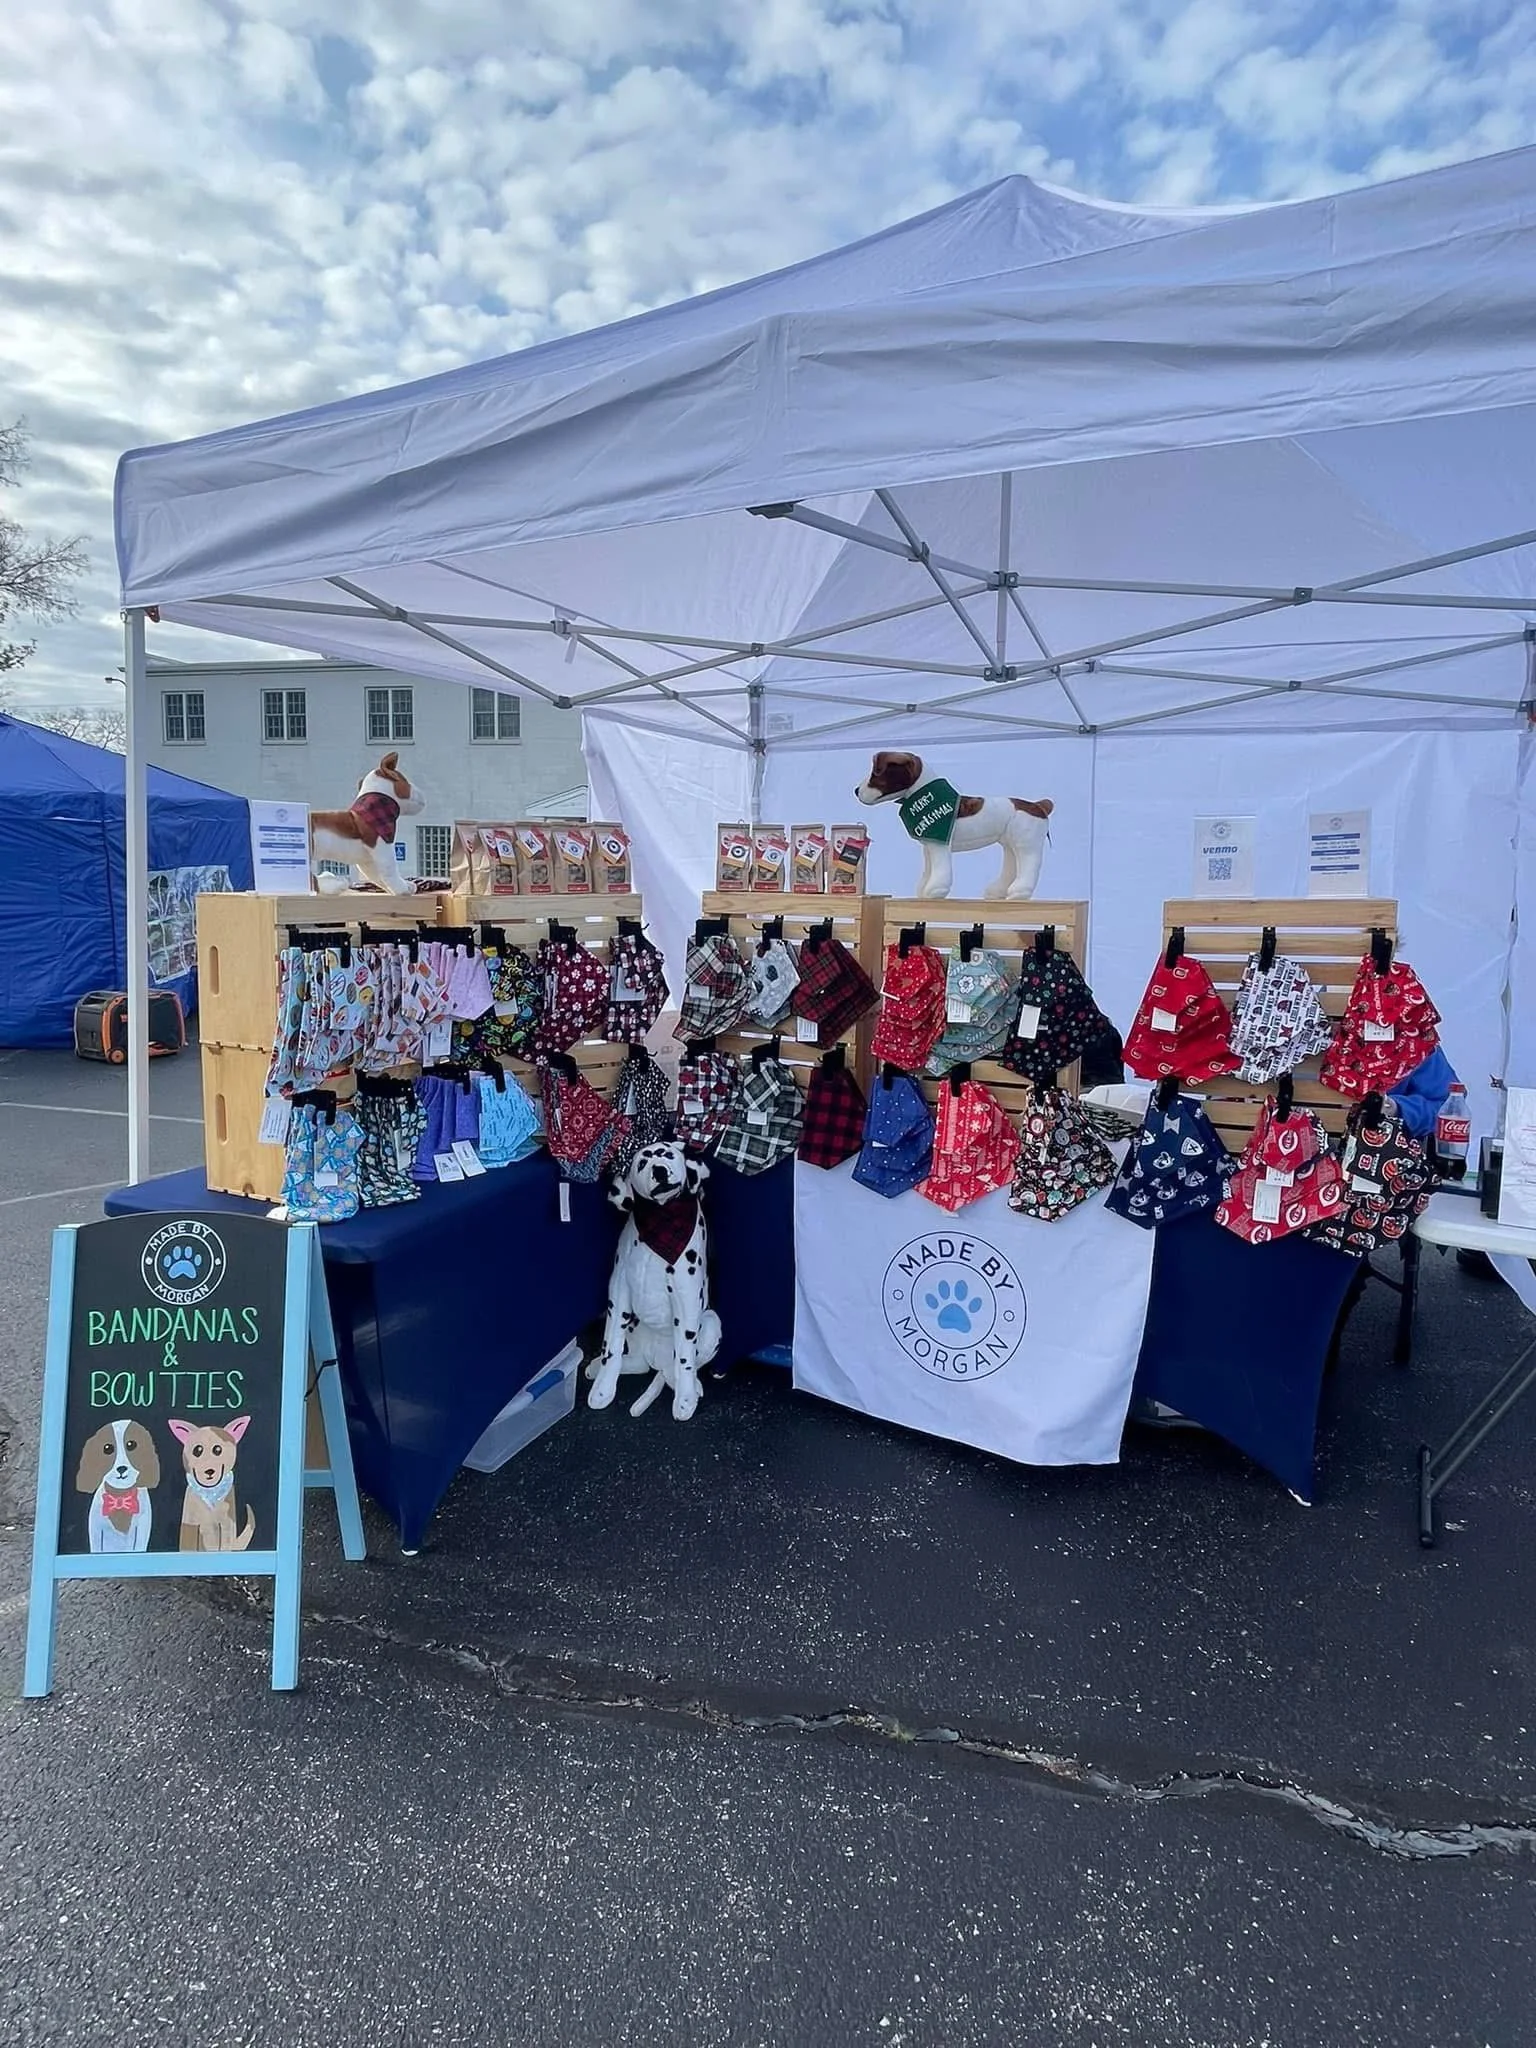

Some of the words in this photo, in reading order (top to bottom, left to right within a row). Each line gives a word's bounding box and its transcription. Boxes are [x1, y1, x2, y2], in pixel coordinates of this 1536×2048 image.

[909, 791, 935, 817] MERRY
[914, 802, 954, 837] CHRISTMAS
[1202, 846, 1239, 855] venmo
[149, 1223, 187, 1251] MADE
[192, 1224, 211, 1238] BY
[898, 1239, 975, 1277] MADE
[981, 1256, 1014, 1288] BY
[154, 1284, 209, 1303] MORGAN
[88, 1307, 259, 1346] BANDANAS
[163, 1342, 179, 1367] &
[895, 1316, 1008, 1374] MORGAN
[91, 1370, 154, 1408] BOW
[159, 1370, 244, 1408] TIES
